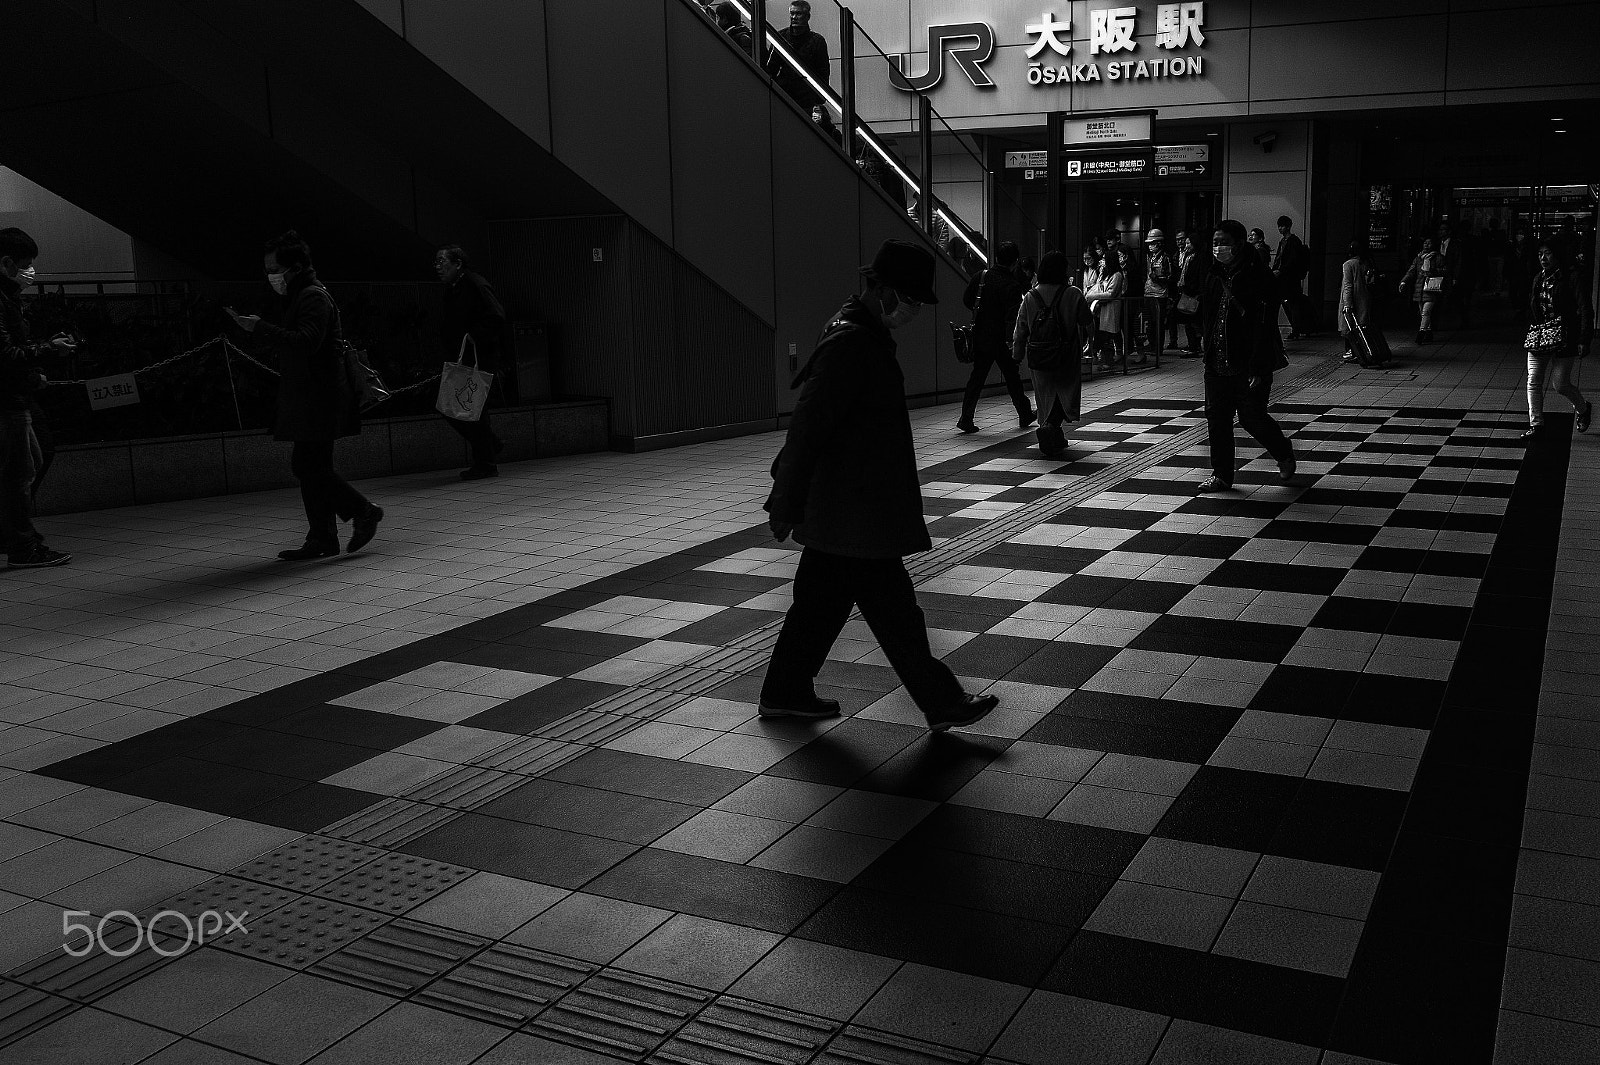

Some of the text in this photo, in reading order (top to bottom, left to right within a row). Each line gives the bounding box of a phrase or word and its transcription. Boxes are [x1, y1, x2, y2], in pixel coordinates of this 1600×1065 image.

[1024, 1, 1205, 59] 大阪駅
[888, 21, 996, 90] JR
[1027, 56, 1203, 85] ŌSAKA STATION
[92, 382, 134, 400] 立入禁止
